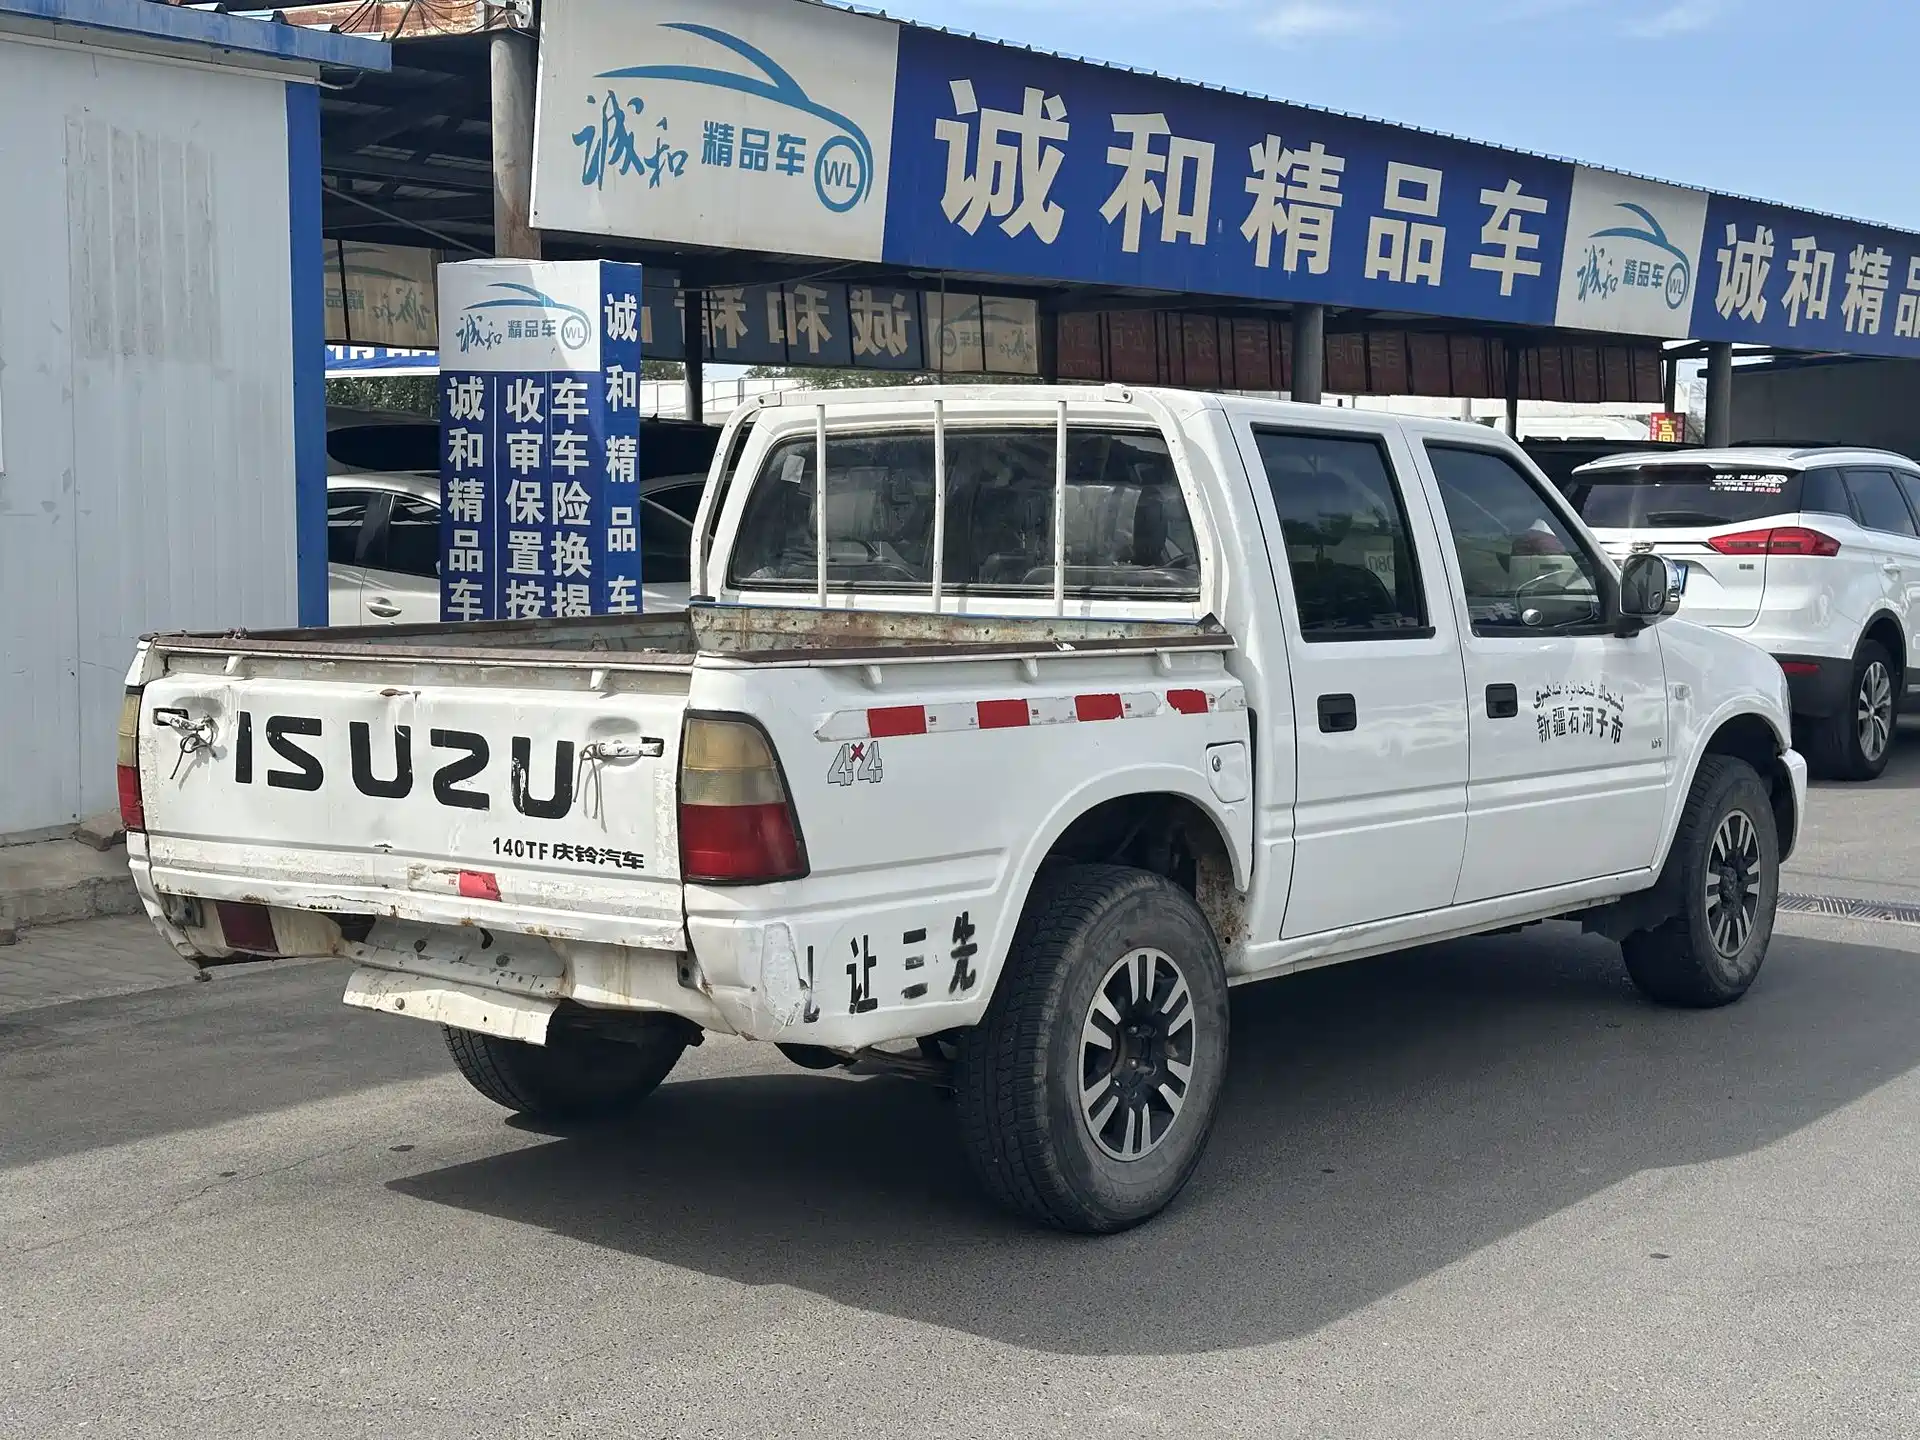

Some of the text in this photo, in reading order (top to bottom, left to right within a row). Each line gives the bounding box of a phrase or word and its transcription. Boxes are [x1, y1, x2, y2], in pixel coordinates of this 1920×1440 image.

[572, 90, 806, 190] 诚和 精品车
[823, 158, 858, 189] WL
[934, 79, 1549, 296] 诚和精品车
[1577, 244, 1665, 302] 诚和 精品车
[1669, 279, 1684, 296] WL
[456, 314, 502, 353] 诚和
[508, 319, 556, 339] 精品车
[565, 326, 583, 340] WL
[604, 293, 638, 614] 诚和精品车
[447, 376, 485, 621] 诚和精品车
[1536, 706, 1624, 744] 新疆石河子市
[235, 710, 574, 820] ISUZU
[492, 837, 645, 870] 140TF 庆铃汽车
